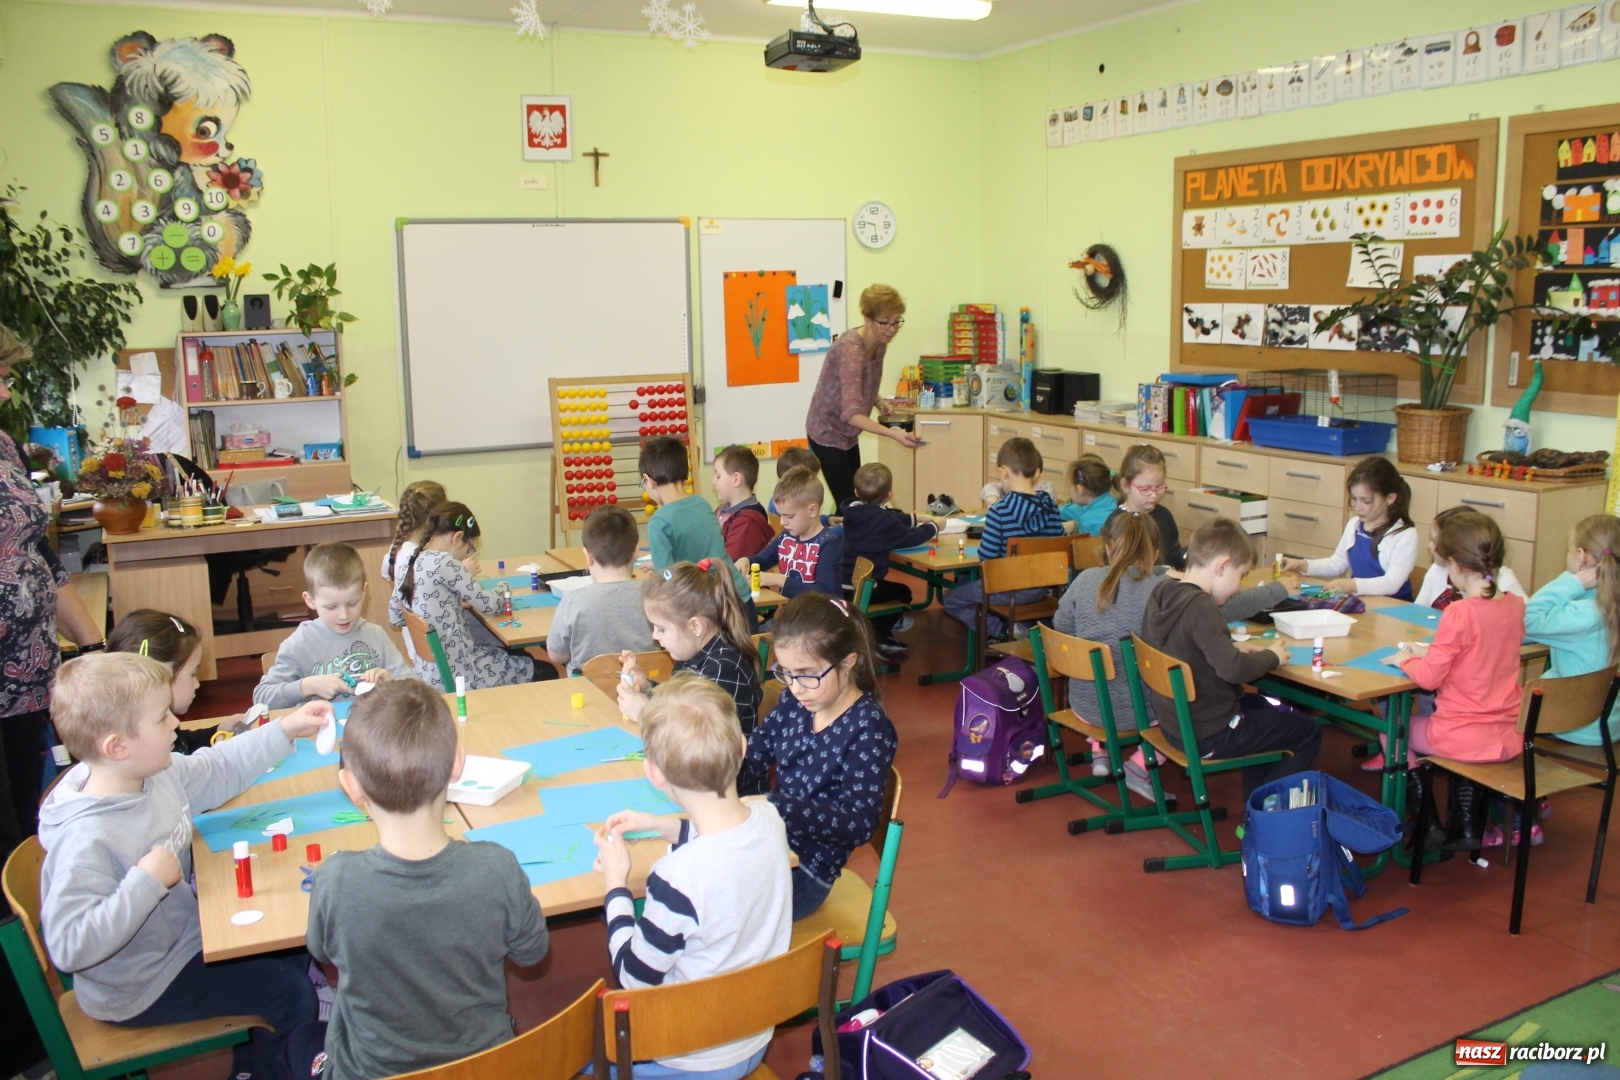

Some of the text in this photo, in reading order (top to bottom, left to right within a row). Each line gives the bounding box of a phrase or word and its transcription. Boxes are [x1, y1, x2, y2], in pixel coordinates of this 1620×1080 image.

[135, 111, 145, 125] 8
[99, 128, 109, 142] 5
[133, 143, 142, 156] 1
[115, 174, 163, 187] 2 6
[1186, 161, 1288, 202] PLANETA
[207, 190, 225, 204] 10
[1450, 193, 1458, 207] 6
[101, 202, 192, 218] 4 3 9
[869, 206, 880, 215] 12
[1343, 201, 1350, 214] 4
[1394, 197, 1401, 211] 5
[1253, 207, 1260, 220] 2
[1296, 205, 1303, 218] 3
[207, 225, 217, 237] 0
[127, 237, 137, 250] 7
[1392, 246, 1400, 260] 0
